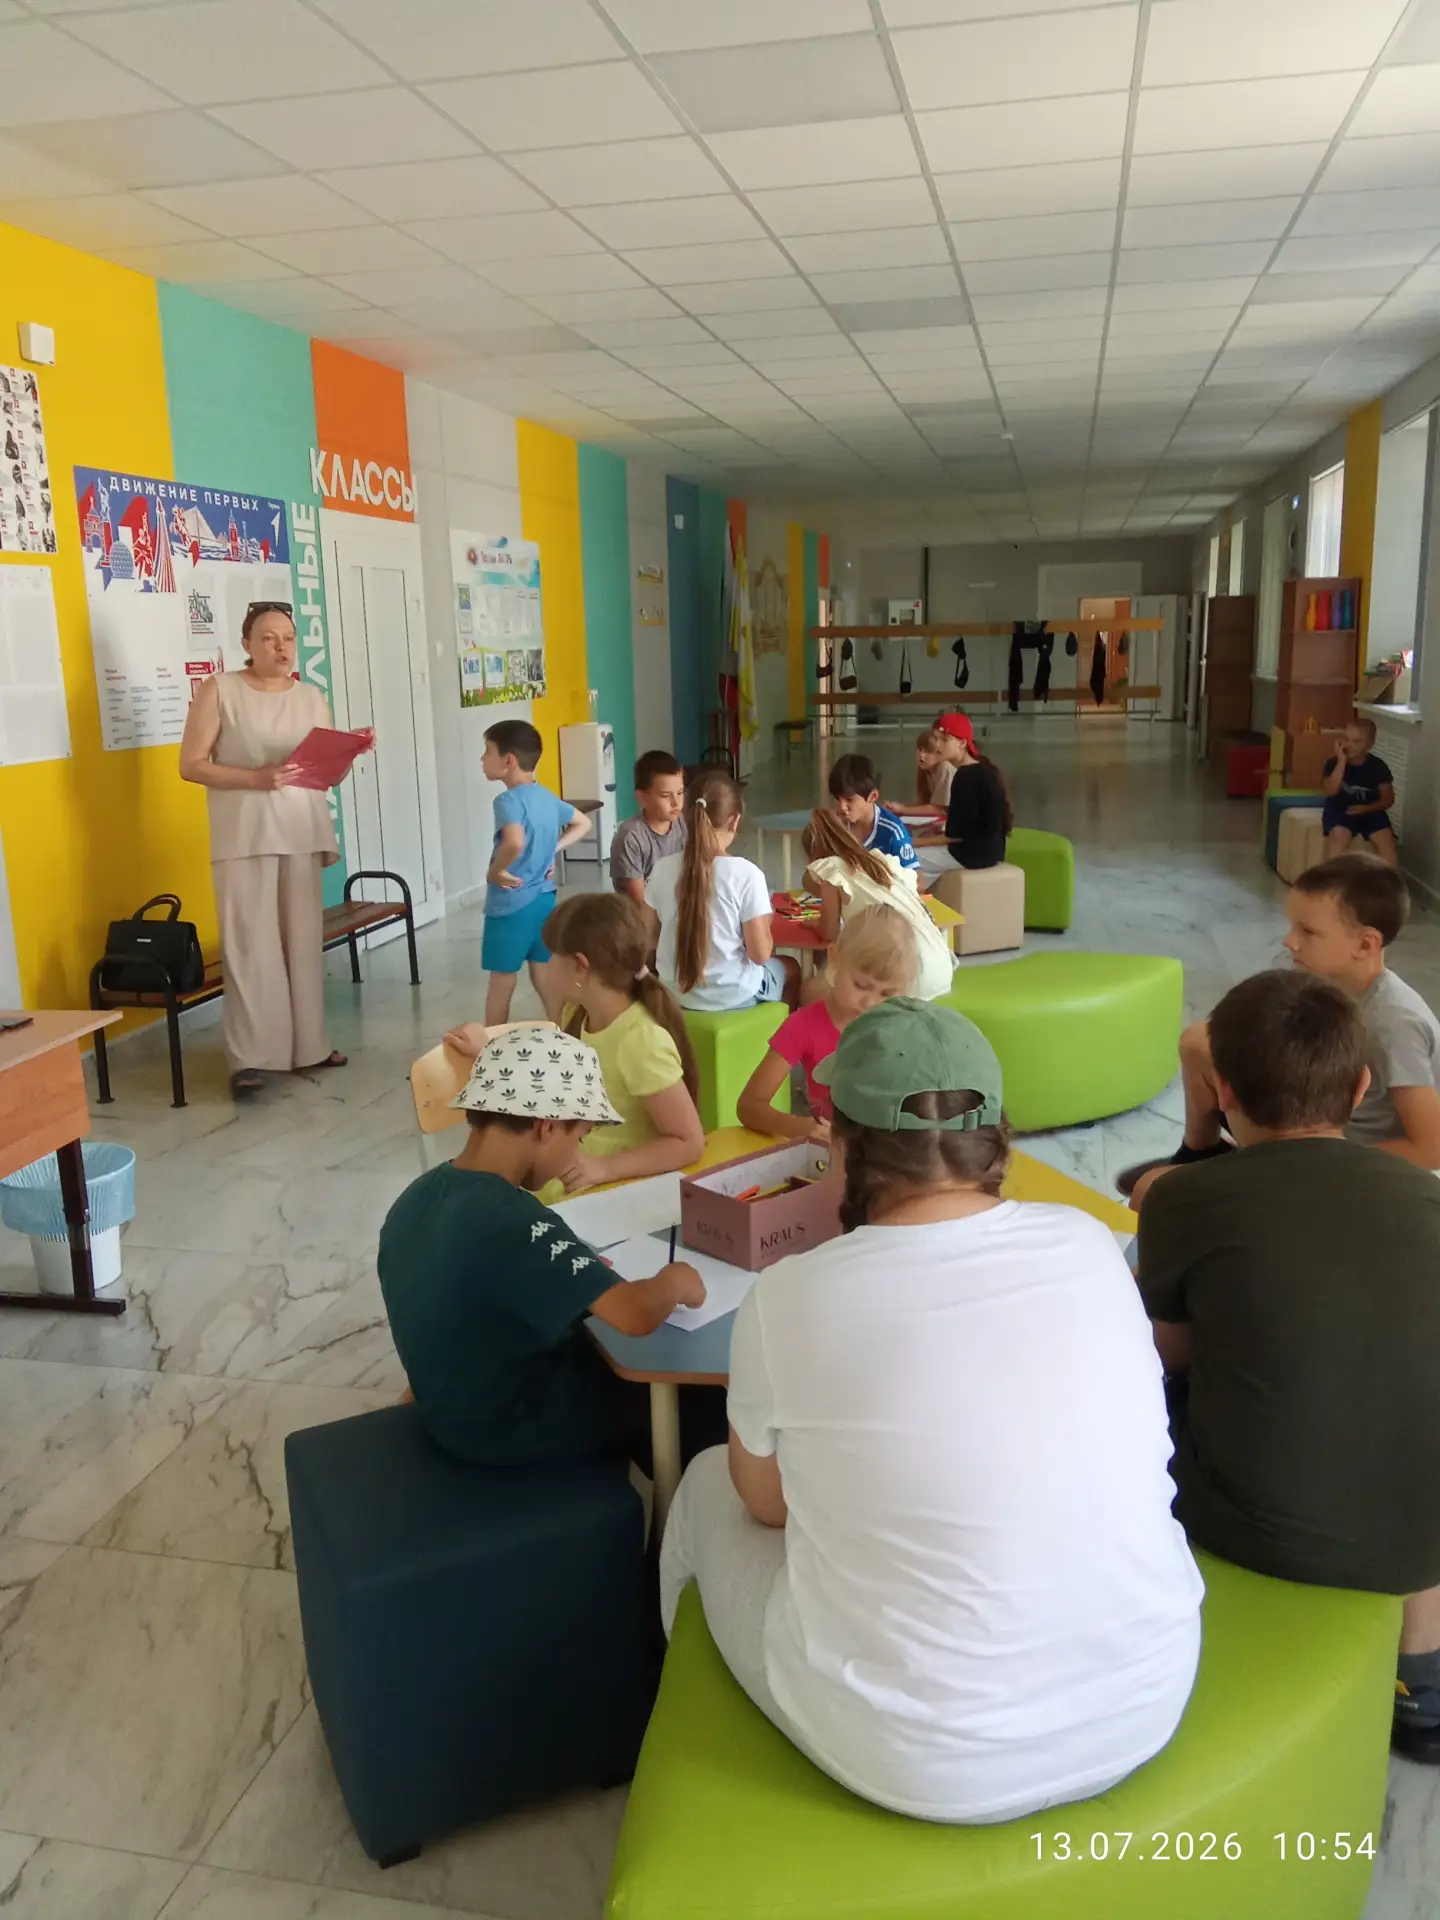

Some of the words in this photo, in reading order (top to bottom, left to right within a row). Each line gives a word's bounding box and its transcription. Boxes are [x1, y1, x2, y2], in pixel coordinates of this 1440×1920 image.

[109, 475, 198, 502] ДВИЖЕНИЕ
[204, 491, 259, 512] ПЕРВЫХ
[309, 447, 418, 514] КЛАССЫ
